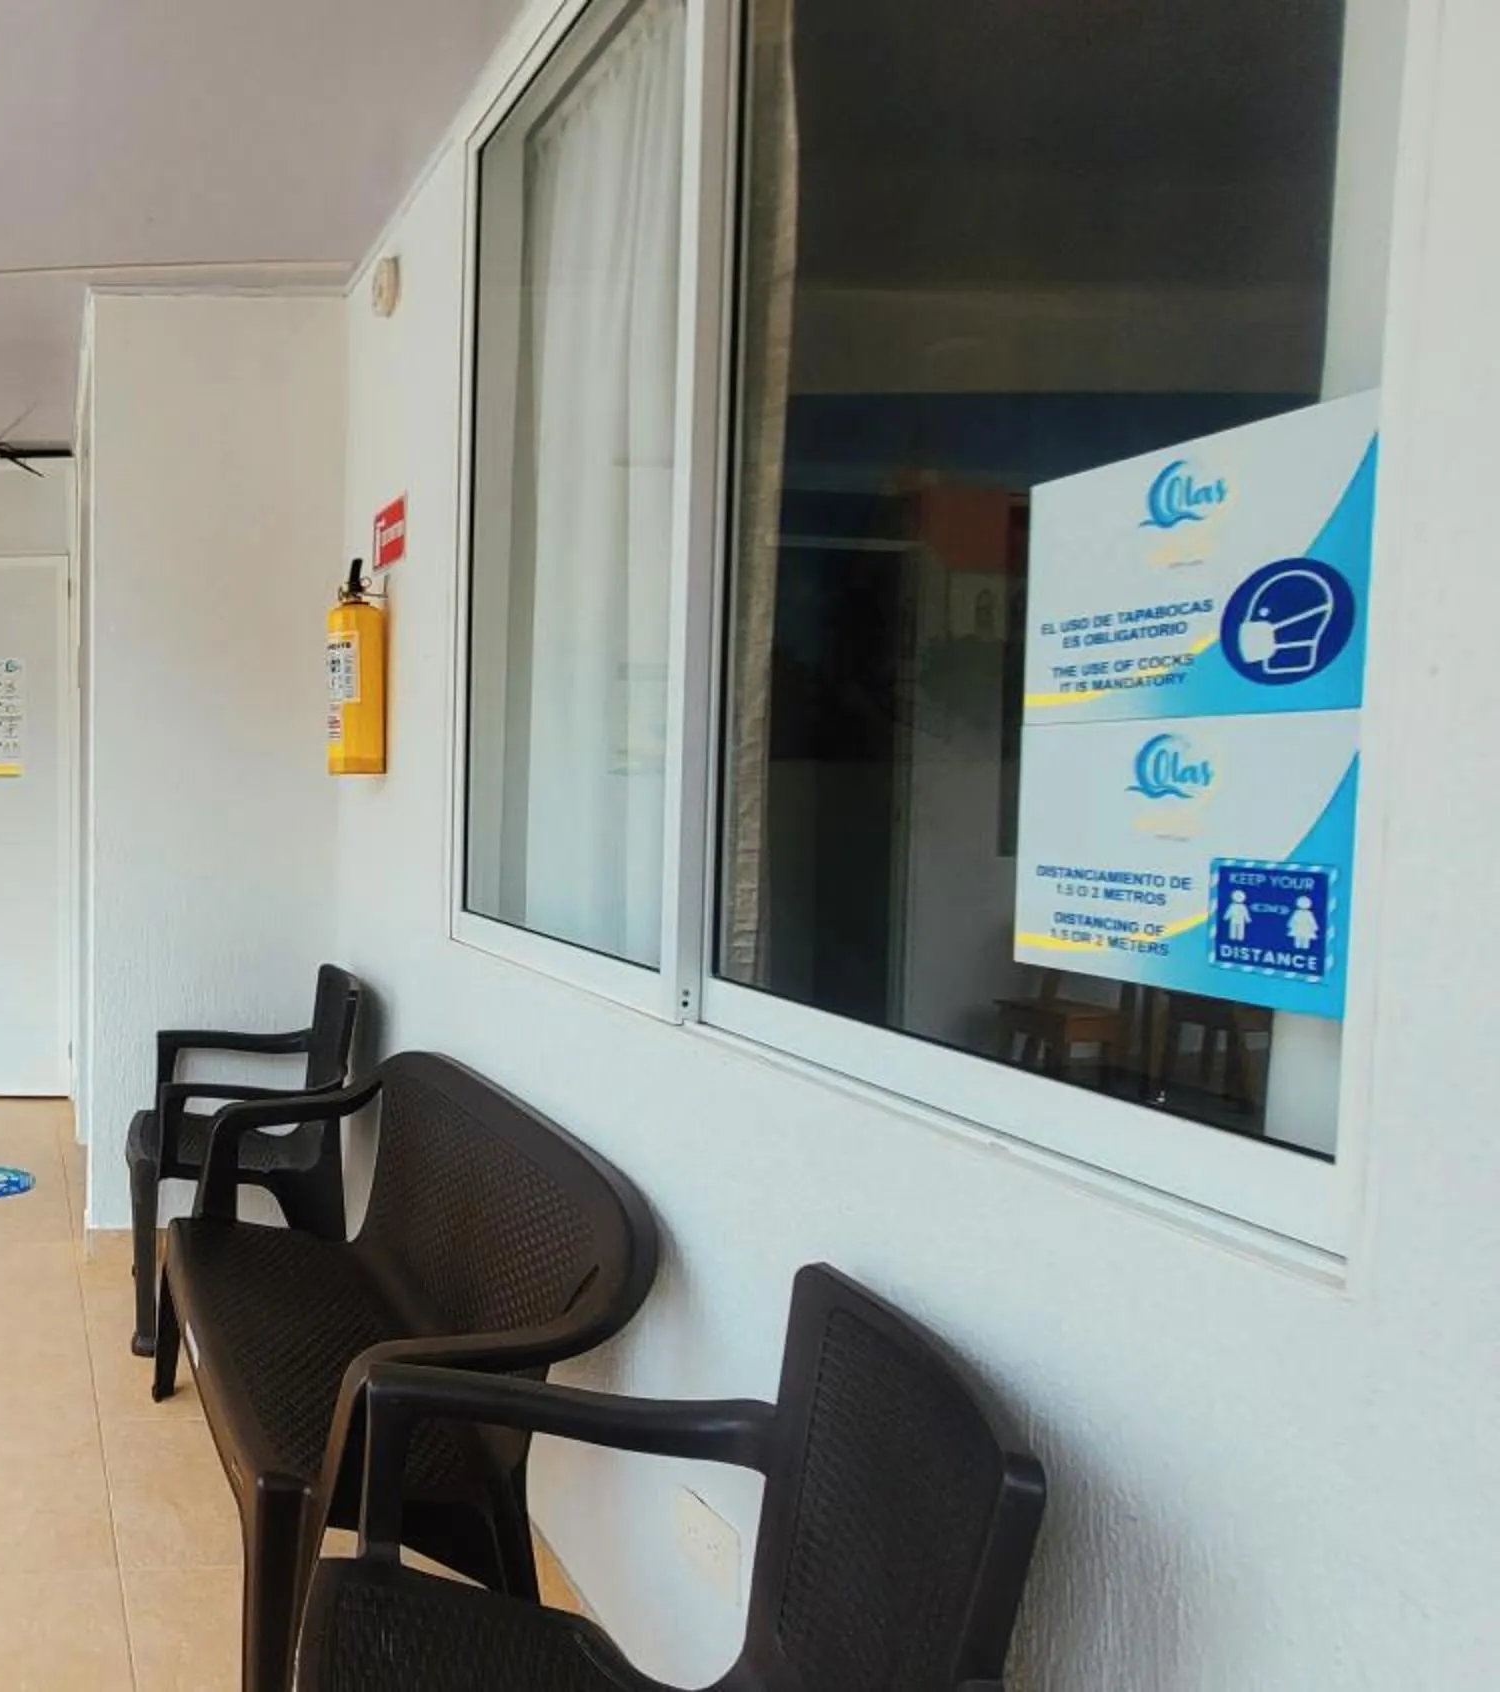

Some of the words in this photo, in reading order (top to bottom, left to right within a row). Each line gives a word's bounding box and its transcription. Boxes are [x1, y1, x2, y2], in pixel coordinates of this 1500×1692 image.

[1040, 624, 1056, 635] EL
[1060, 618, 1090, 633] USO
[1093, 614, 1114, 627] DE
[1117, 600, 1214, 624] TAPABOCAS
[1062, 636, 1082, 649] ES
[1083, 621, 1188, 646] OBLIGATORIO
[1052, 665, 1078, 678] THE
[1081, 662, 1109, 676] USE
[1114, 659, 1134, 672] OF
[1137, 653, 1195, 669] COCKS
[1059, 682, 1073, 692] IT
[1092, 672, 1188, 690] MANDATORY
[1036, 865, 1165, 888] DISTANCIAMIENTO
[1169, 876, 1192, 890] DE
[1229, 873, 1267, 886] KEEP
[1269, 875, 1316, 890] YOUR
[1103, 888, 1167, 906] METROS
[1054, 911, 1139, 933] DISTANCING
[1143, 923, 1165, 936] OF
[1071, 931, 1090, 943] OR
[1107, 936, 1170, 956] METERS
[1220, 944, 1318, 971] DISTANCE
